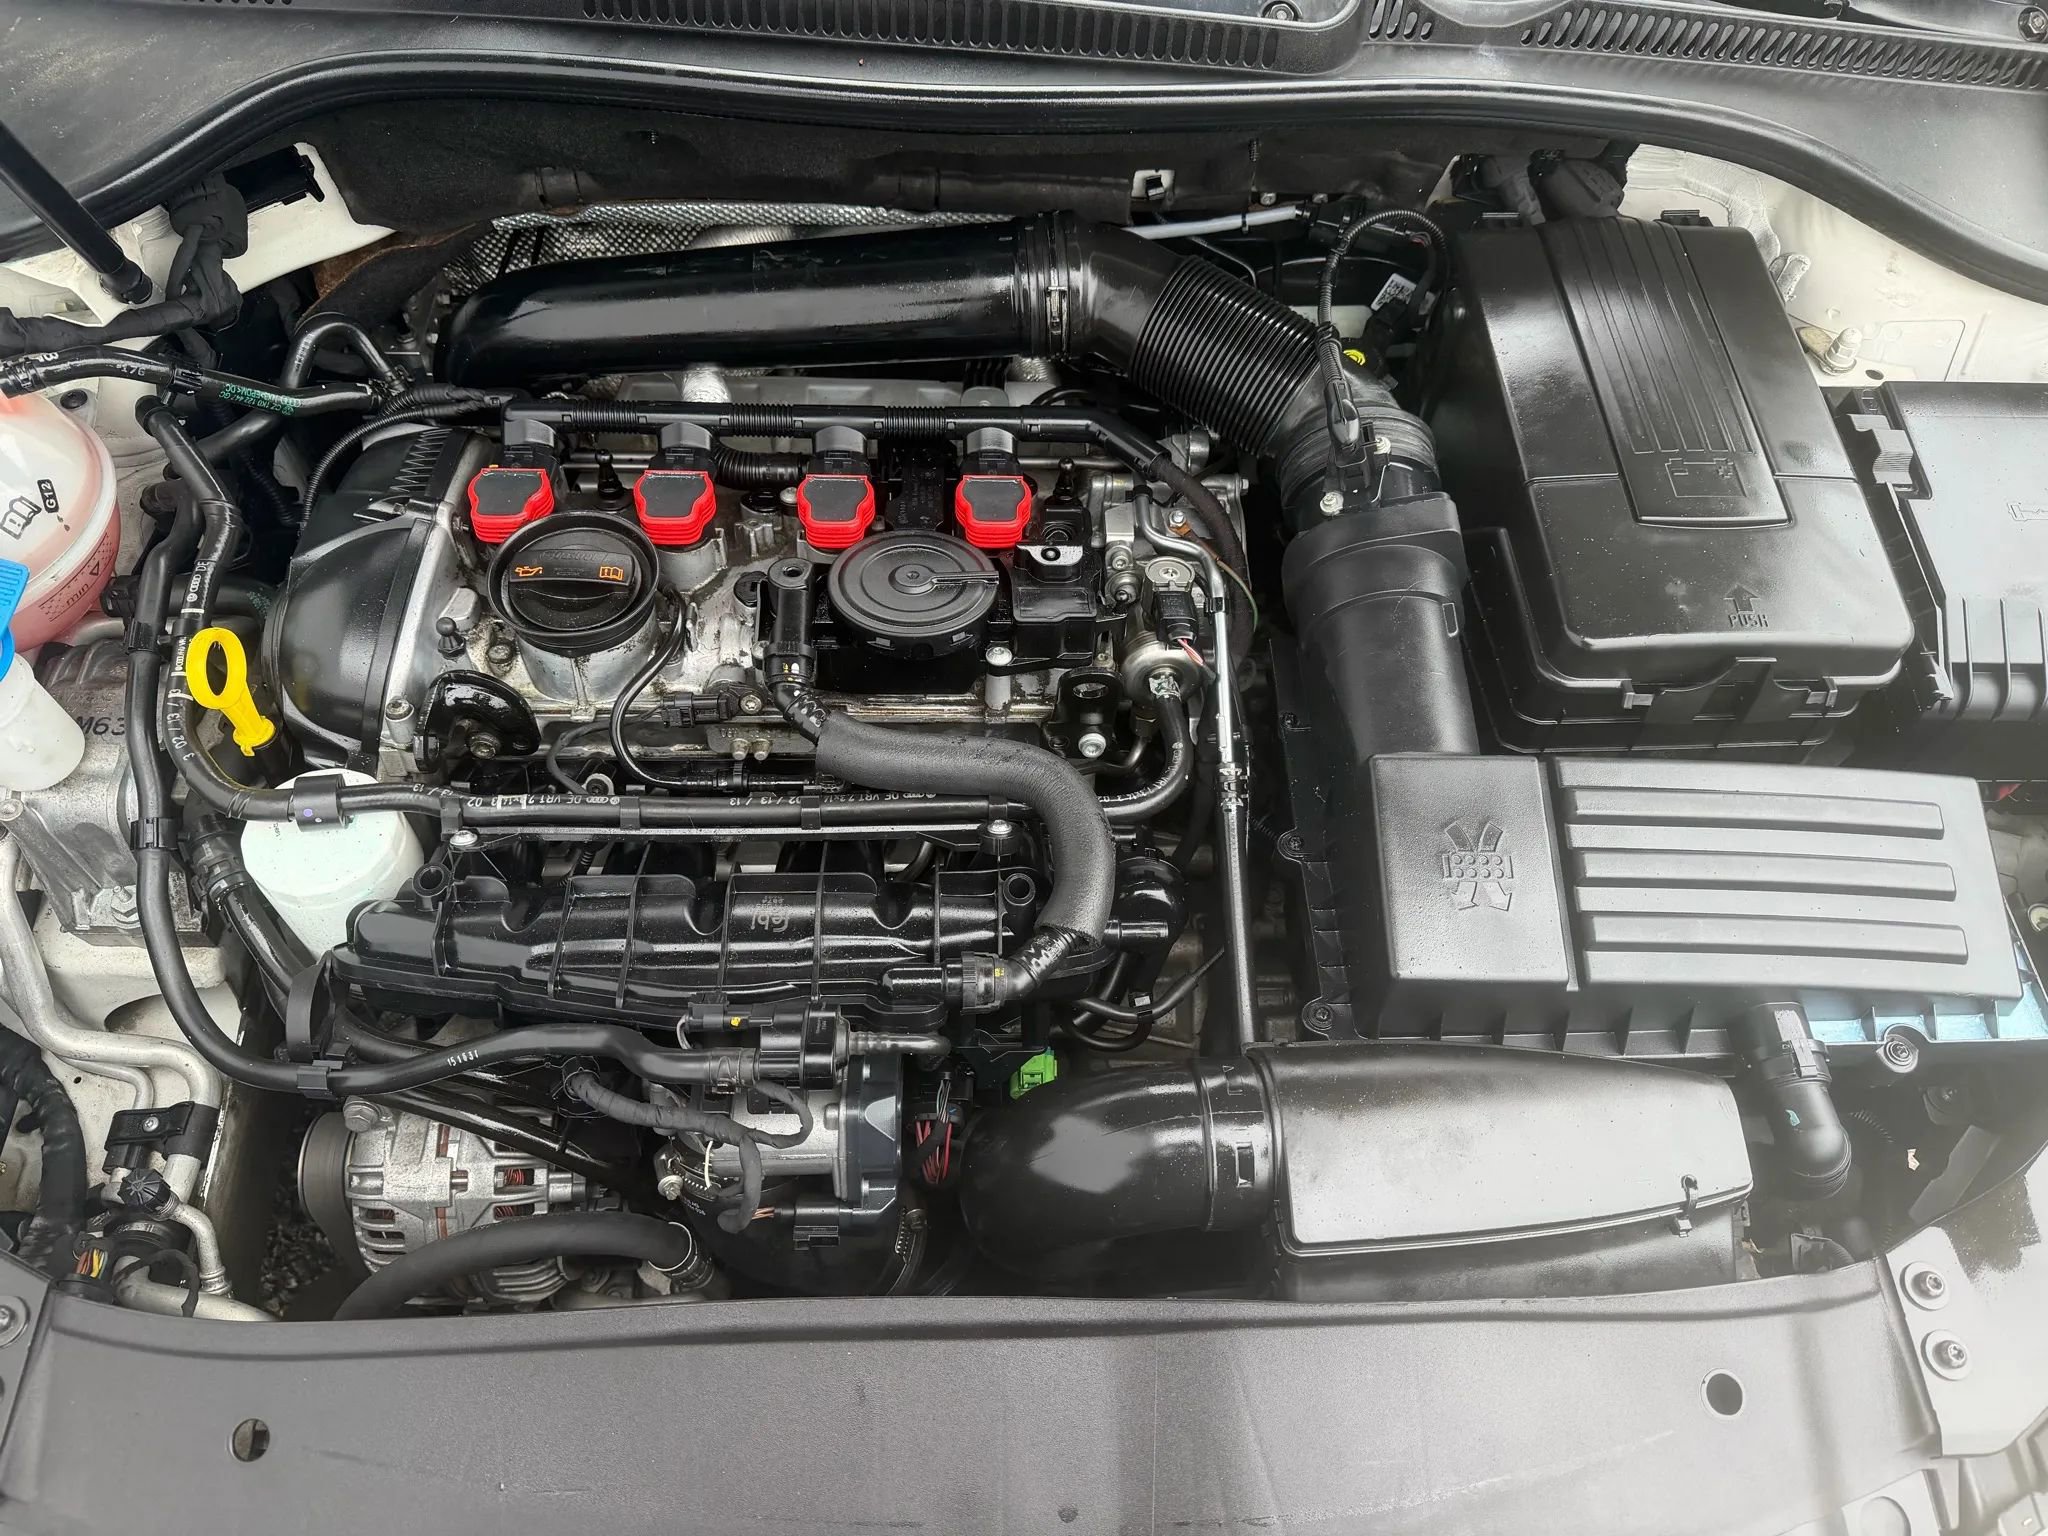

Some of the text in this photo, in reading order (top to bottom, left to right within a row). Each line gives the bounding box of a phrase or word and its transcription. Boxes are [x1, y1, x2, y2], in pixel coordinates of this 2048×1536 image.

[40, 481, 55, 510] G12
[195, 561, 210, 572] DE
[1727, 614, 1769, 628] PUSH
[467, 796, 484, 807] 02
[539, 794, 562, 804] VRT
[566, 794, 583, 804] DE
[729, 797, 741, 806] 13
[760, 796, 773, 805] 13
[859, 793, 880, 802] VRT
